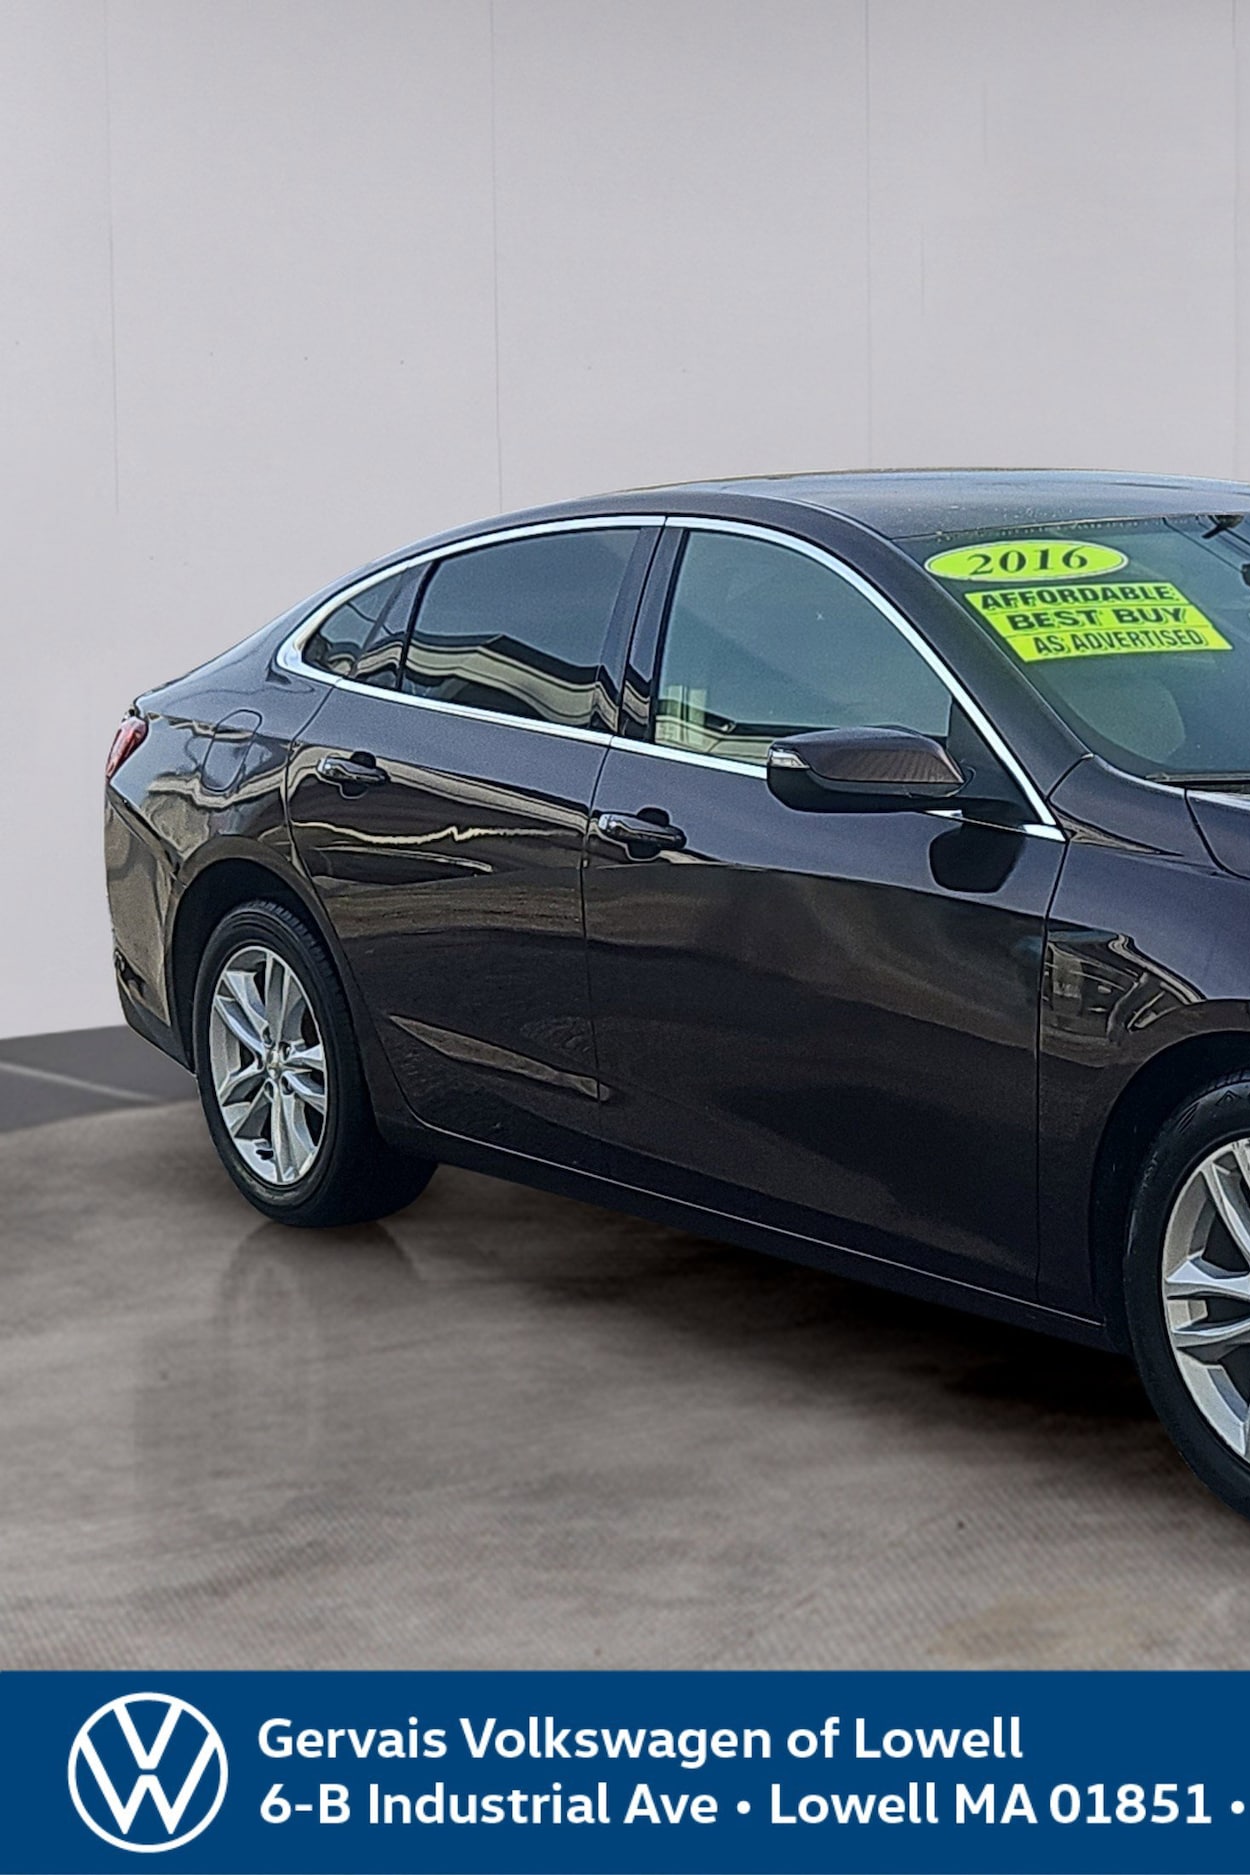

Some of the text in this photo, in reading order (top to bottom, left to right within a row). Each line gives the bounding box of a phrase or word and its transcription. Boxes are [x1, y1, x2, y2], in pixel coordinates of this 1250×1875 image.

[968, 546, 1088, 575] 2016
[980, 586, 1175, 610] AFFORDABLE
[1007, 607, 1187, 631] BEST BUY
